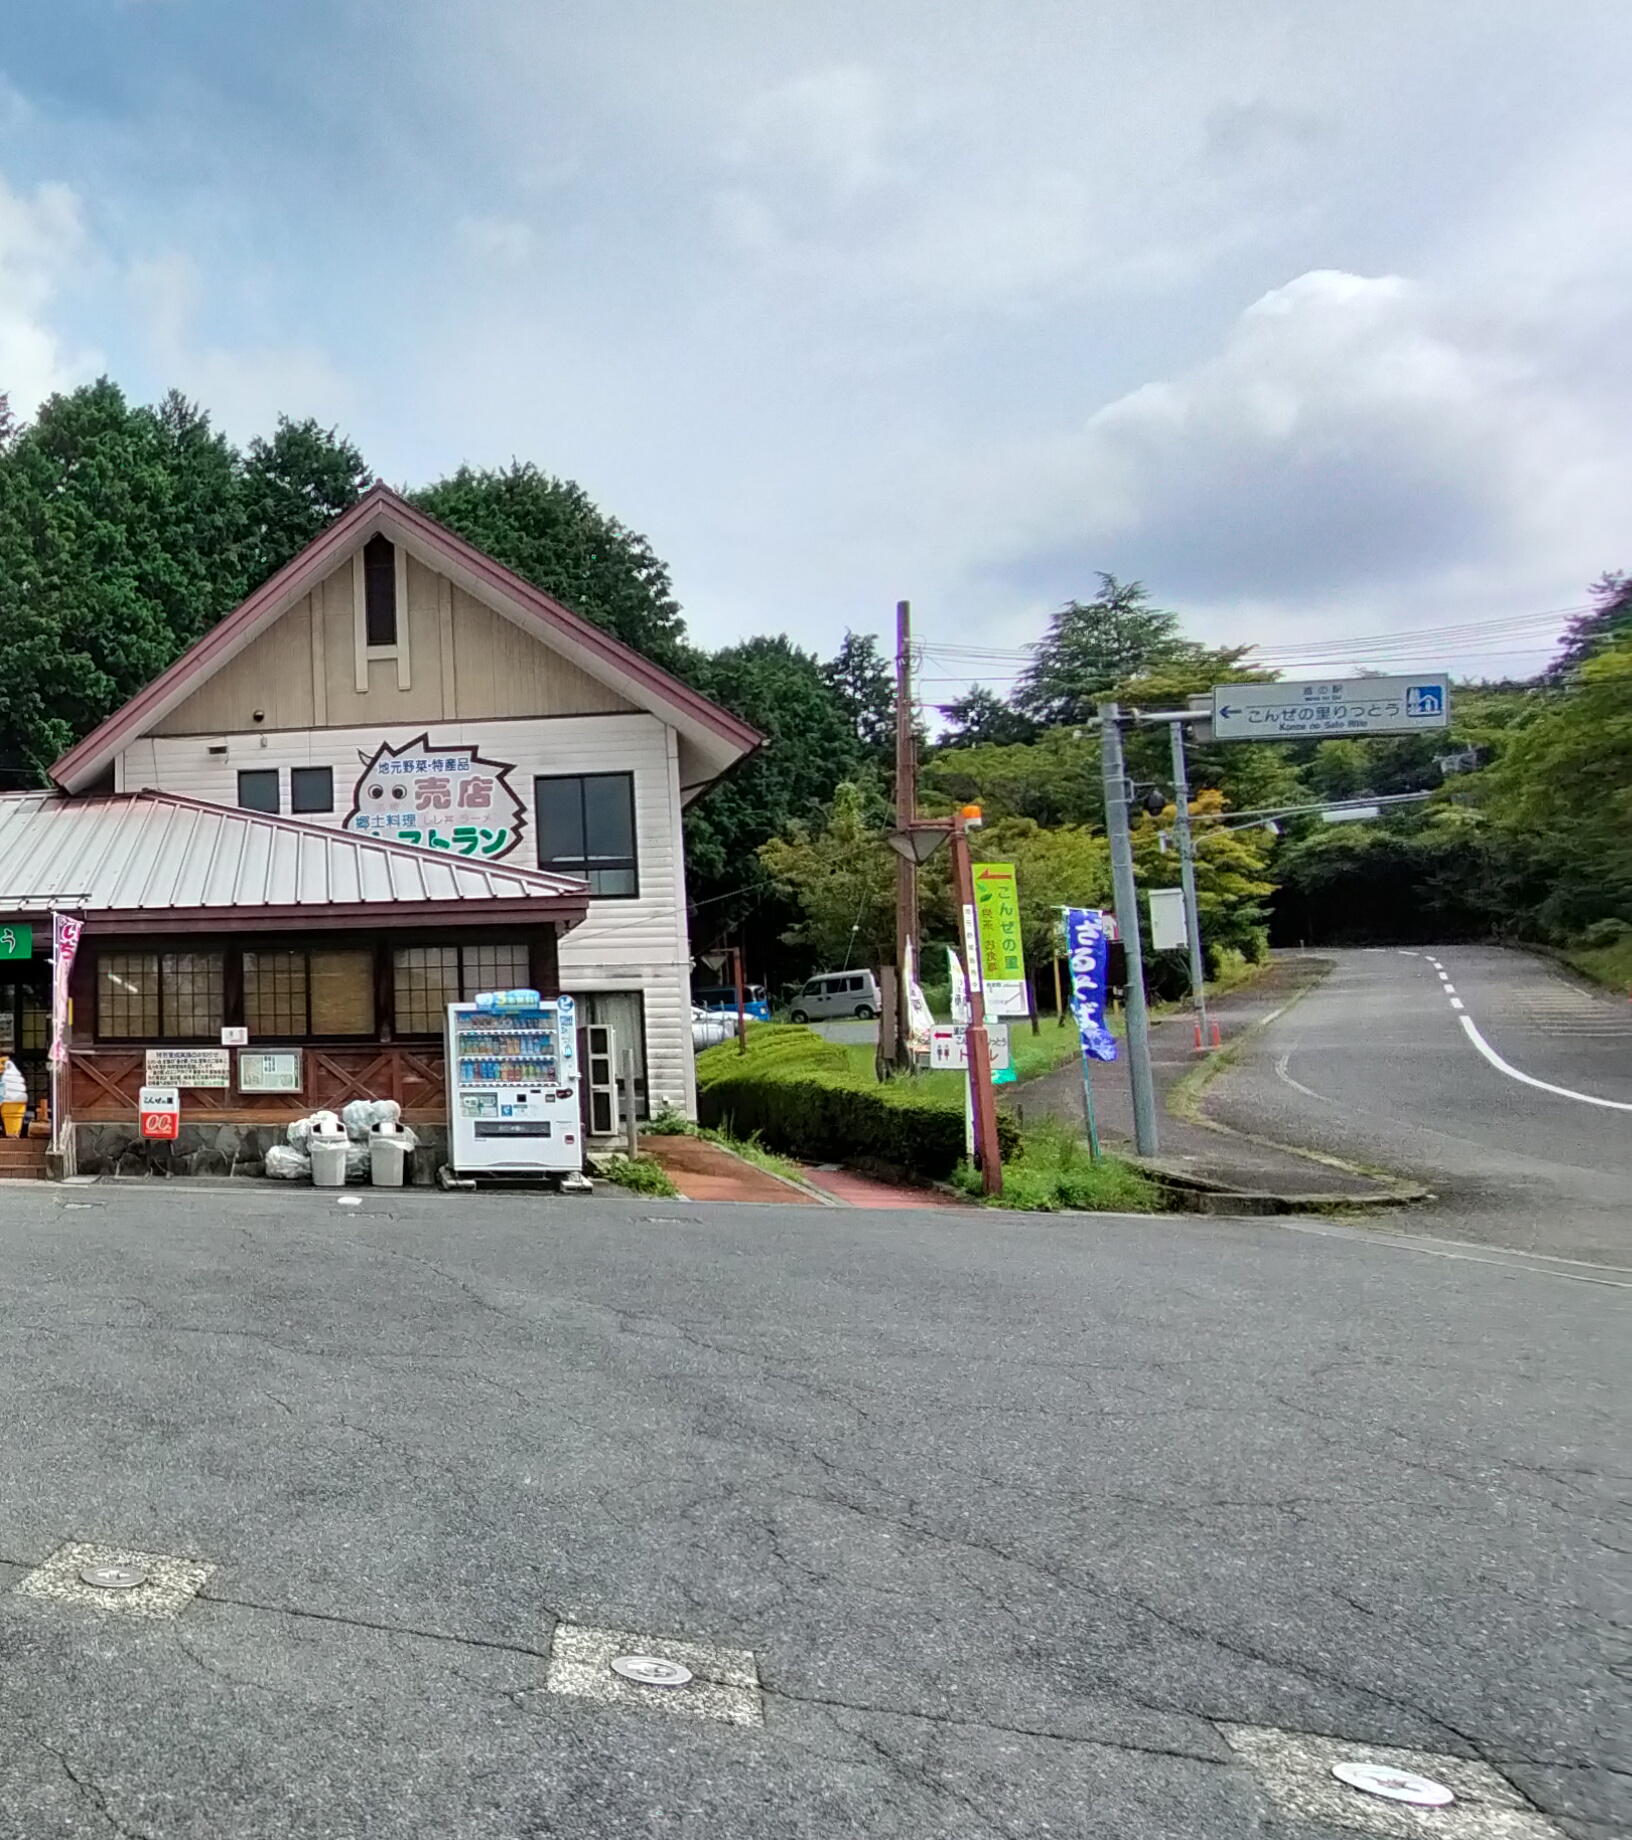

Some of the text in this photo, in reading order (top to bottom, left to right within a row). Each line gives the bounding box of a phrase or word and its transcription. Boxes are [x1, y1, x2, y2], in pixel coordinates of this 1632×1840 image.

[1324, 721, 1344, 730] Sato
[377, 757, 471, 775] 地元野菜・特産品
[414, 776, 494, 811] 売店
[355, 813, 416, 830] 郷土料理
[459, 812, 495, 824] ラーメ
[997, 885, 1019, 971] こんぜの里
